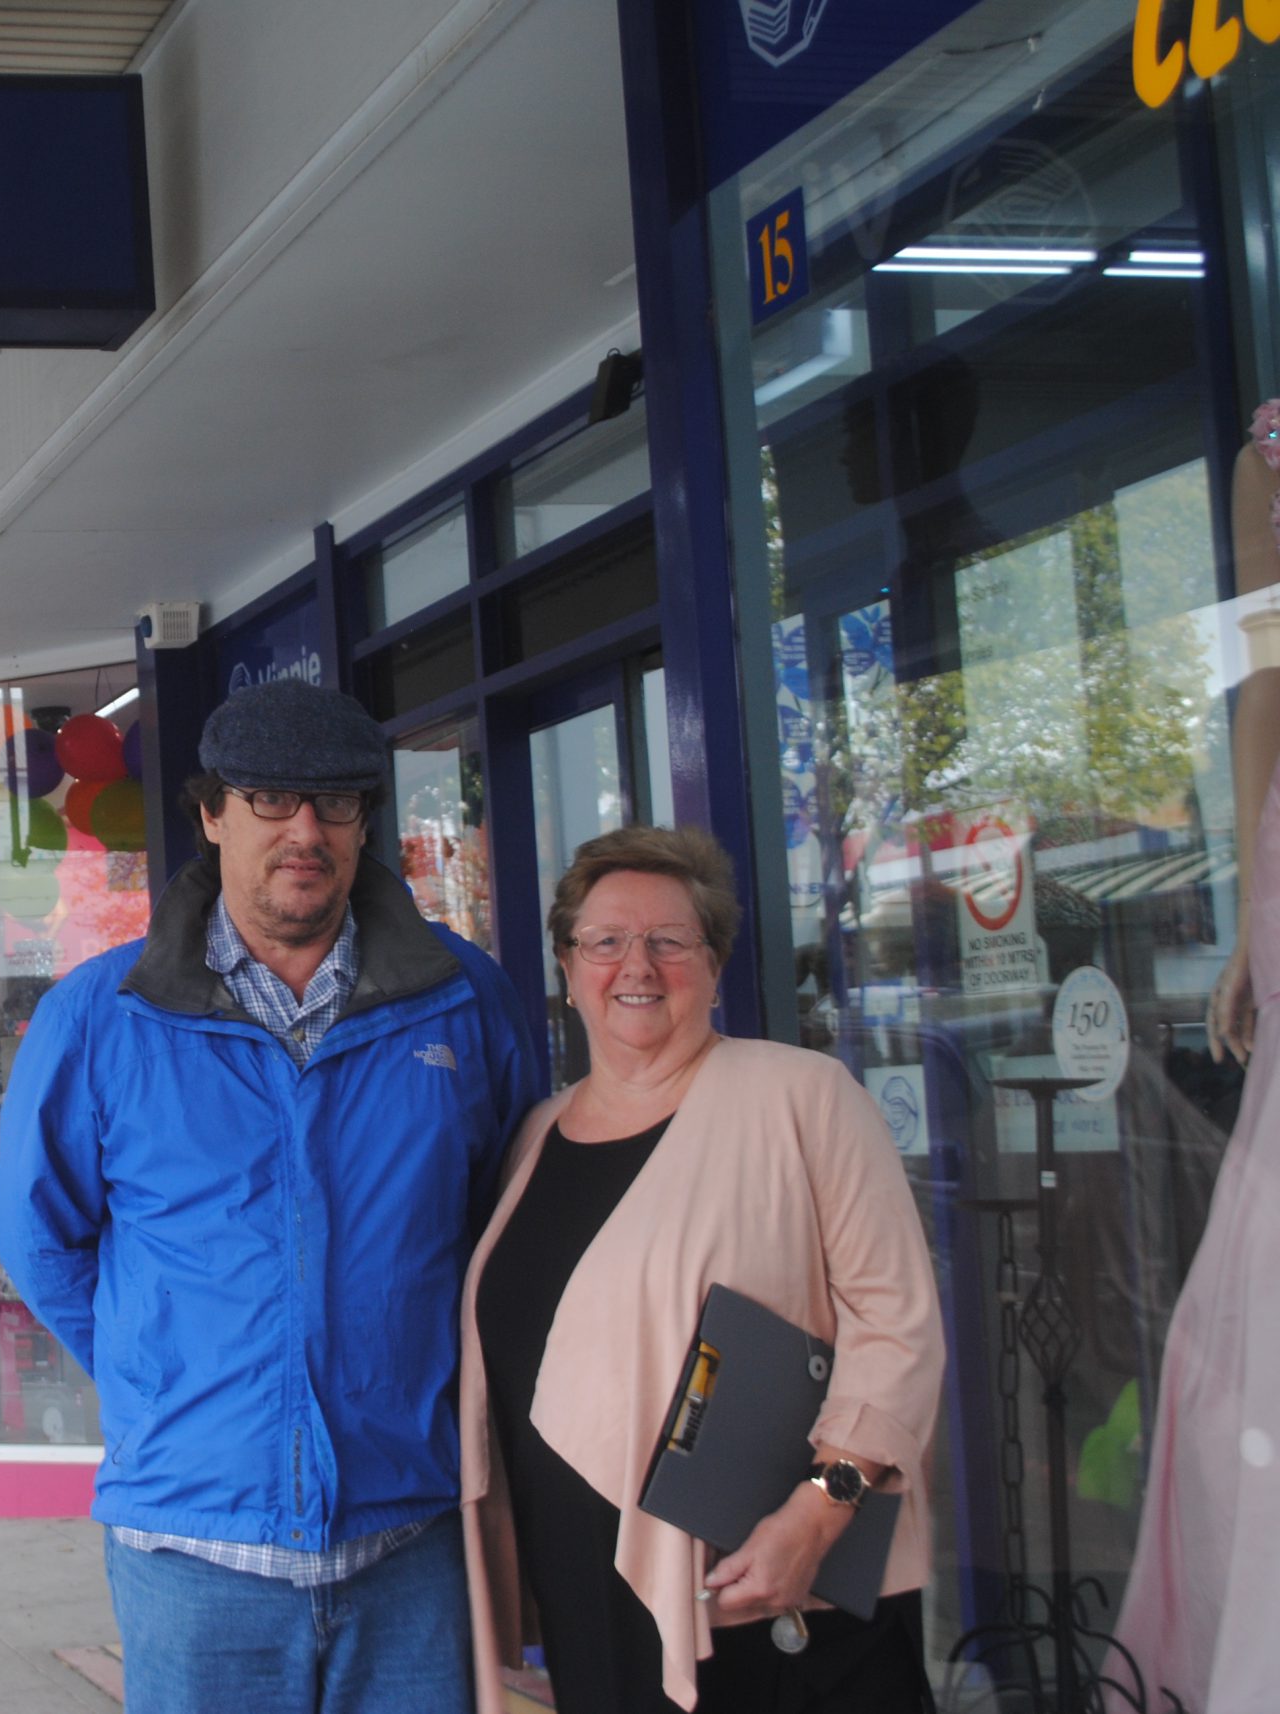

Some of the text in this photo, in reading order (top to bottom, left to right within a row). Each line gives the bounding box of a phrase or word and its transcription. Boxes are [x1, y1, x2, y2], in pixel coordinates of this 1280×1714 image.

[757, 209, 795, 305] 15
[984, 931, 1025, 949] SMOKING
[984, 967, 1029, 985] DOORWAY
[1066, 1000, 1110, 1036] 150
